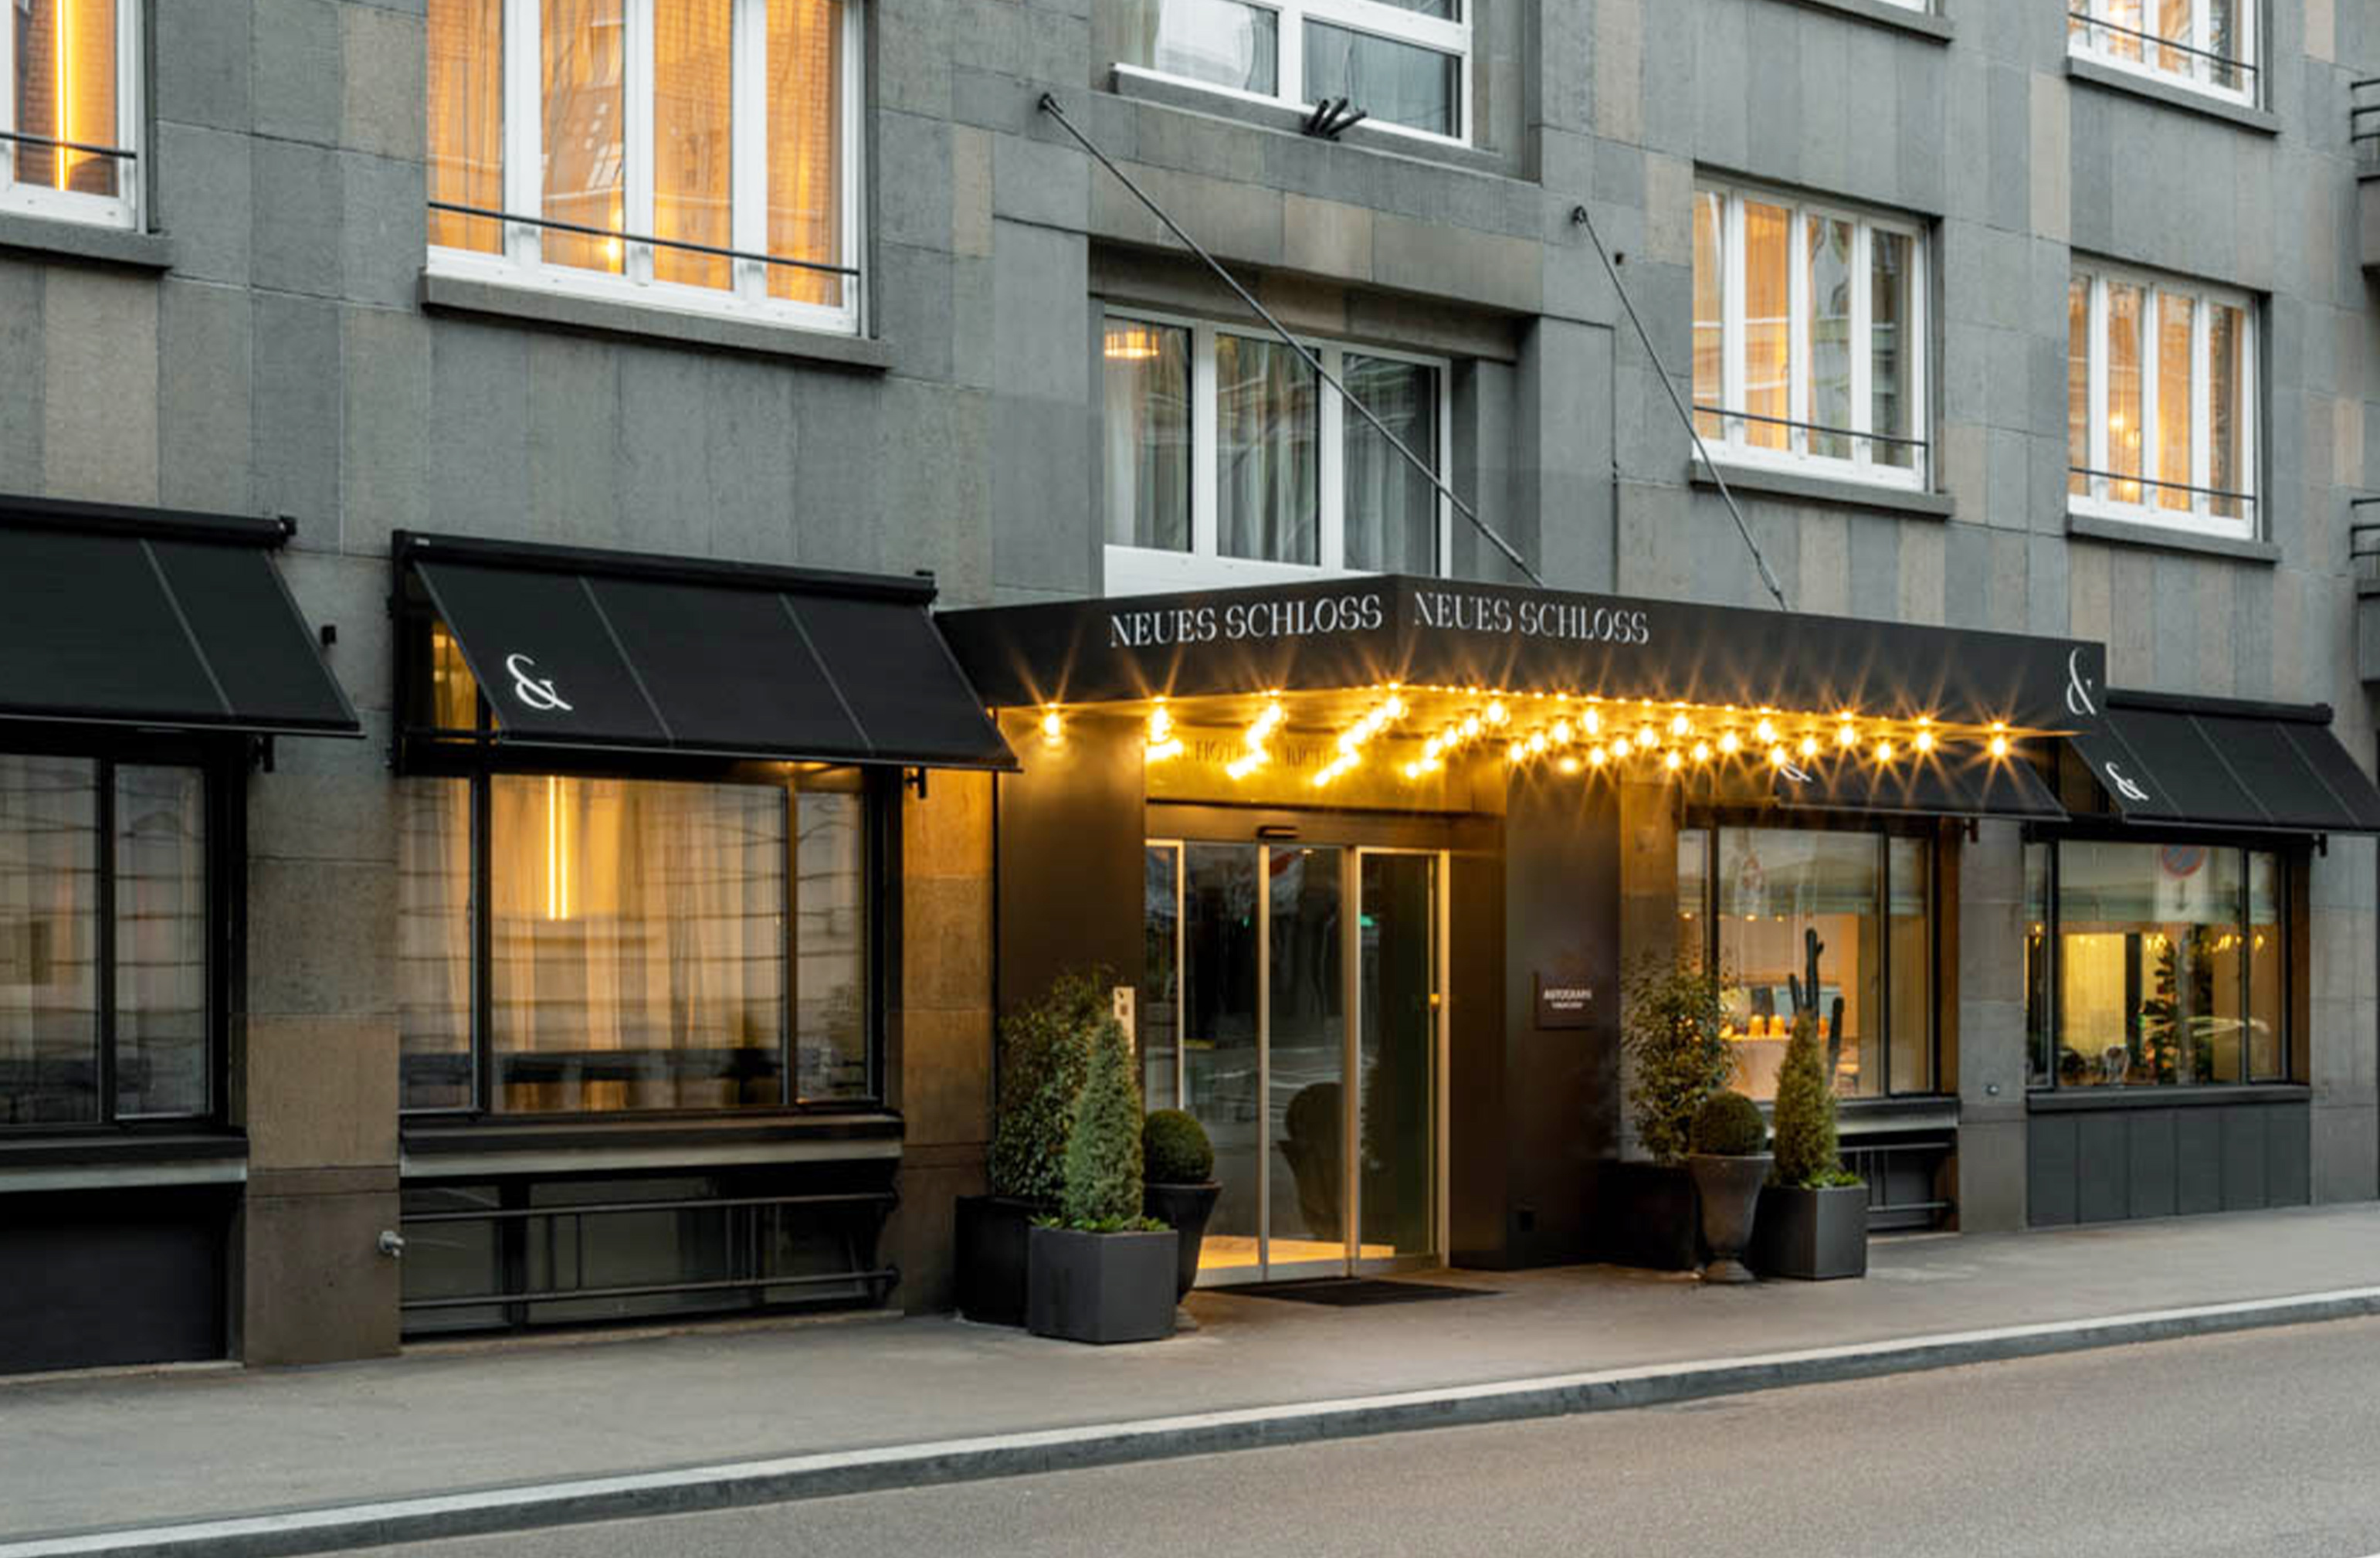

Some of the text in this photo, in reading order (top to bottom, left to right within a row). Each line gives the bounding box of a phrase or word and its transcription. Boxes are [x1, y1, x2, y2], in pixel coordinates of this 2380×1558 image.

[1110, 593, 1382, 648] NEUES SCHLOSS
[1414, 591, 1649, 644] NEUES SCHLOSS
[506, 653, 573, 711] &
[2066, 647, 2096, 715] &
[2105, 762, 2150, 801] &
